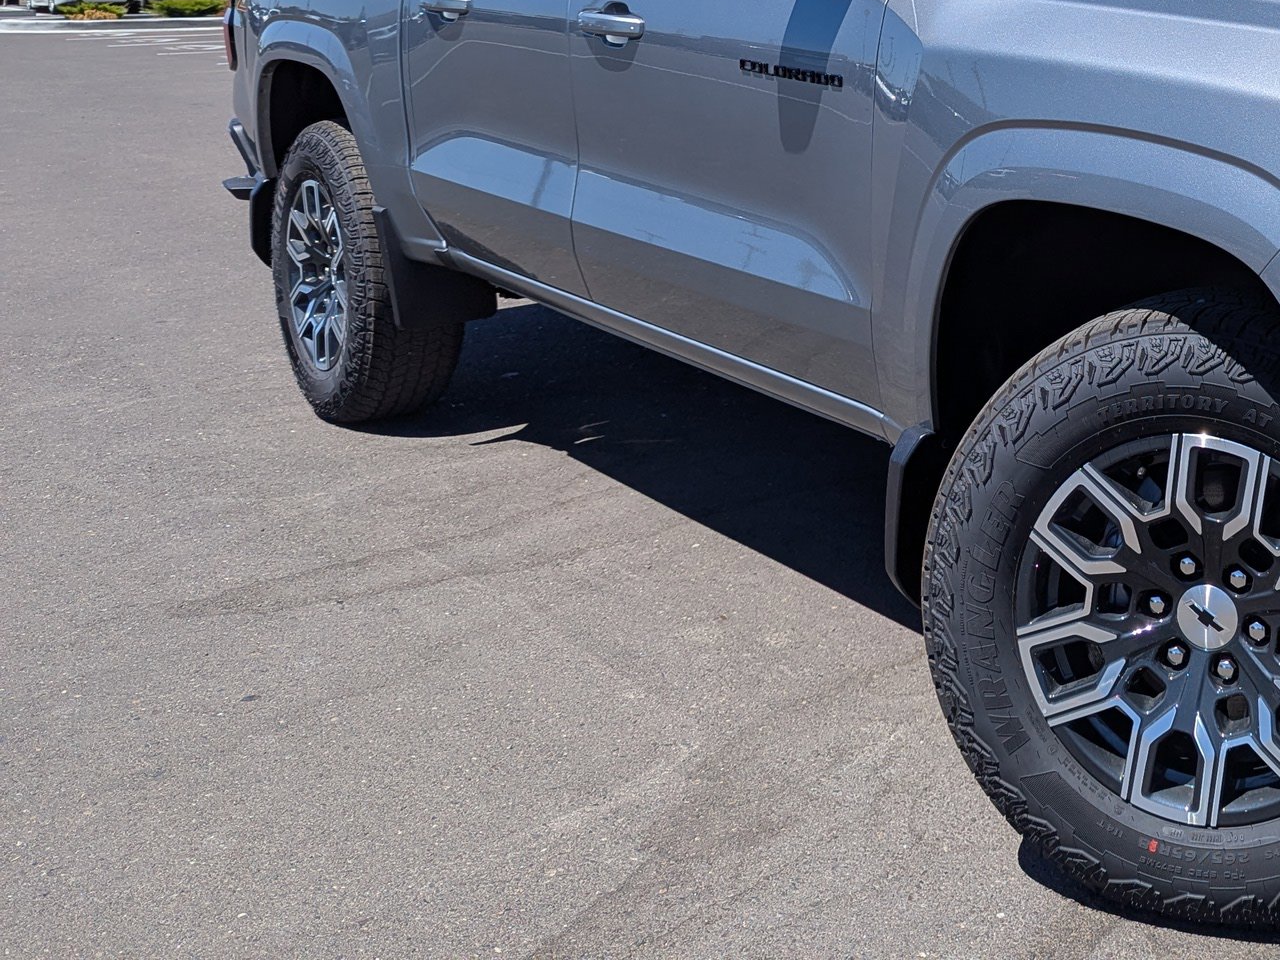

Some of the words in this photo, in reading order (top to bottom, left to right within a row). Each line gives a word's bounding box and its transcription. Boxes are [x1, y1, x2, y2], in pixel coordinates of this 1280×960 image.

[739, 58, 844, 88] COLORADO
[1096, 393, 1230, 425] TERRITORY
[1241, 408, 1273, 428] AT
[964, 480, 1031, 757] WRANGLER
[1186, 868, 1218, 880] SPEC
